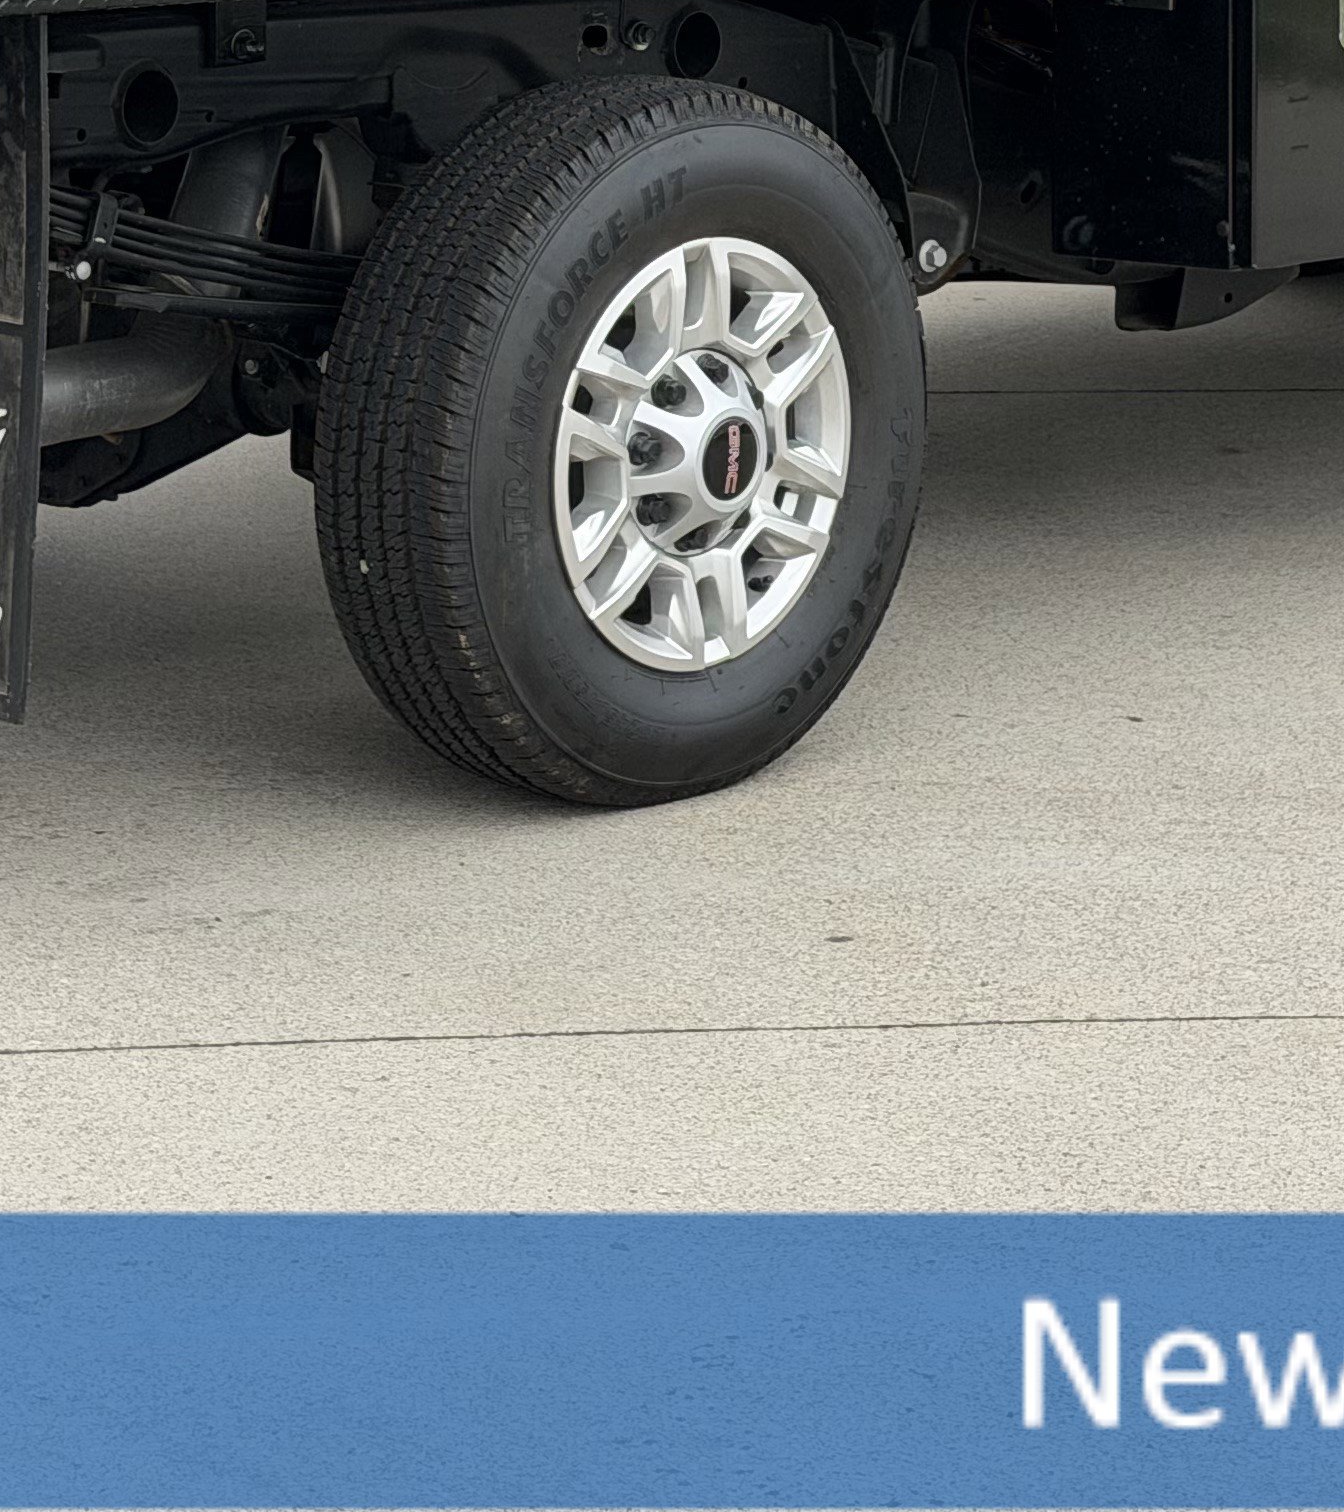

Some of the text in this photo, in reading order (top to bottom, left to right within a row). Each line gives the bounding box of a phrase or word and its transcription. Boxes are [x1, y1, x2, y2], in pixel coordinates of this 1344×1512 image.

[503, 207, 629, 544] TRANSFORCE
[640, 166, 689, 221] HT
[724, 424, 741, 495] GMC
